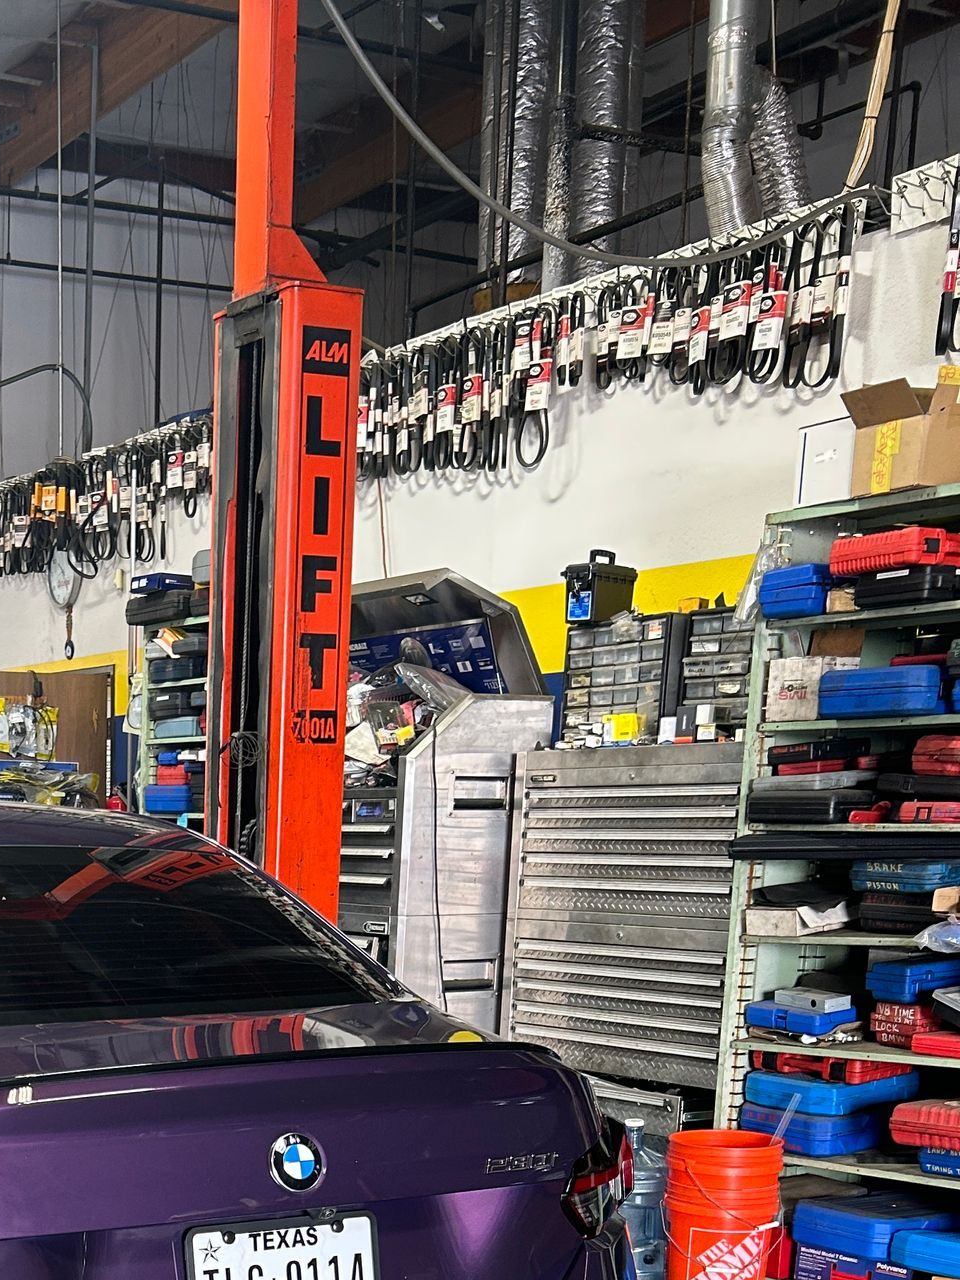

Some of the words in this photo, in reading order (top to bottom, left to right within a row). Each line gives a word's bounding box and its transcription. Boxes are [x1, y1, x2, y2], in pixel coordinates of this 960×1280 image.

[305, 339, 348, 364] ALM
[299, 395, 342, 690] LIFT
[866, 862, 904, 873] BRAKE
[866, 881, 899, 891] PISTON
[879, 1004, 891, 1016] V8
[892, 1005, 915, 1020] TIME
[875, 1020, 900, 1033] LOCK
[881, 1032, 906, 1043] BMW
[926, 1163, 954, 1175] TIMING
[248, 1226, 319, 1252] TEXAS
[696, 1238, 733, 1268] THE
[876, 1262, 908, 1275] Polyvance
